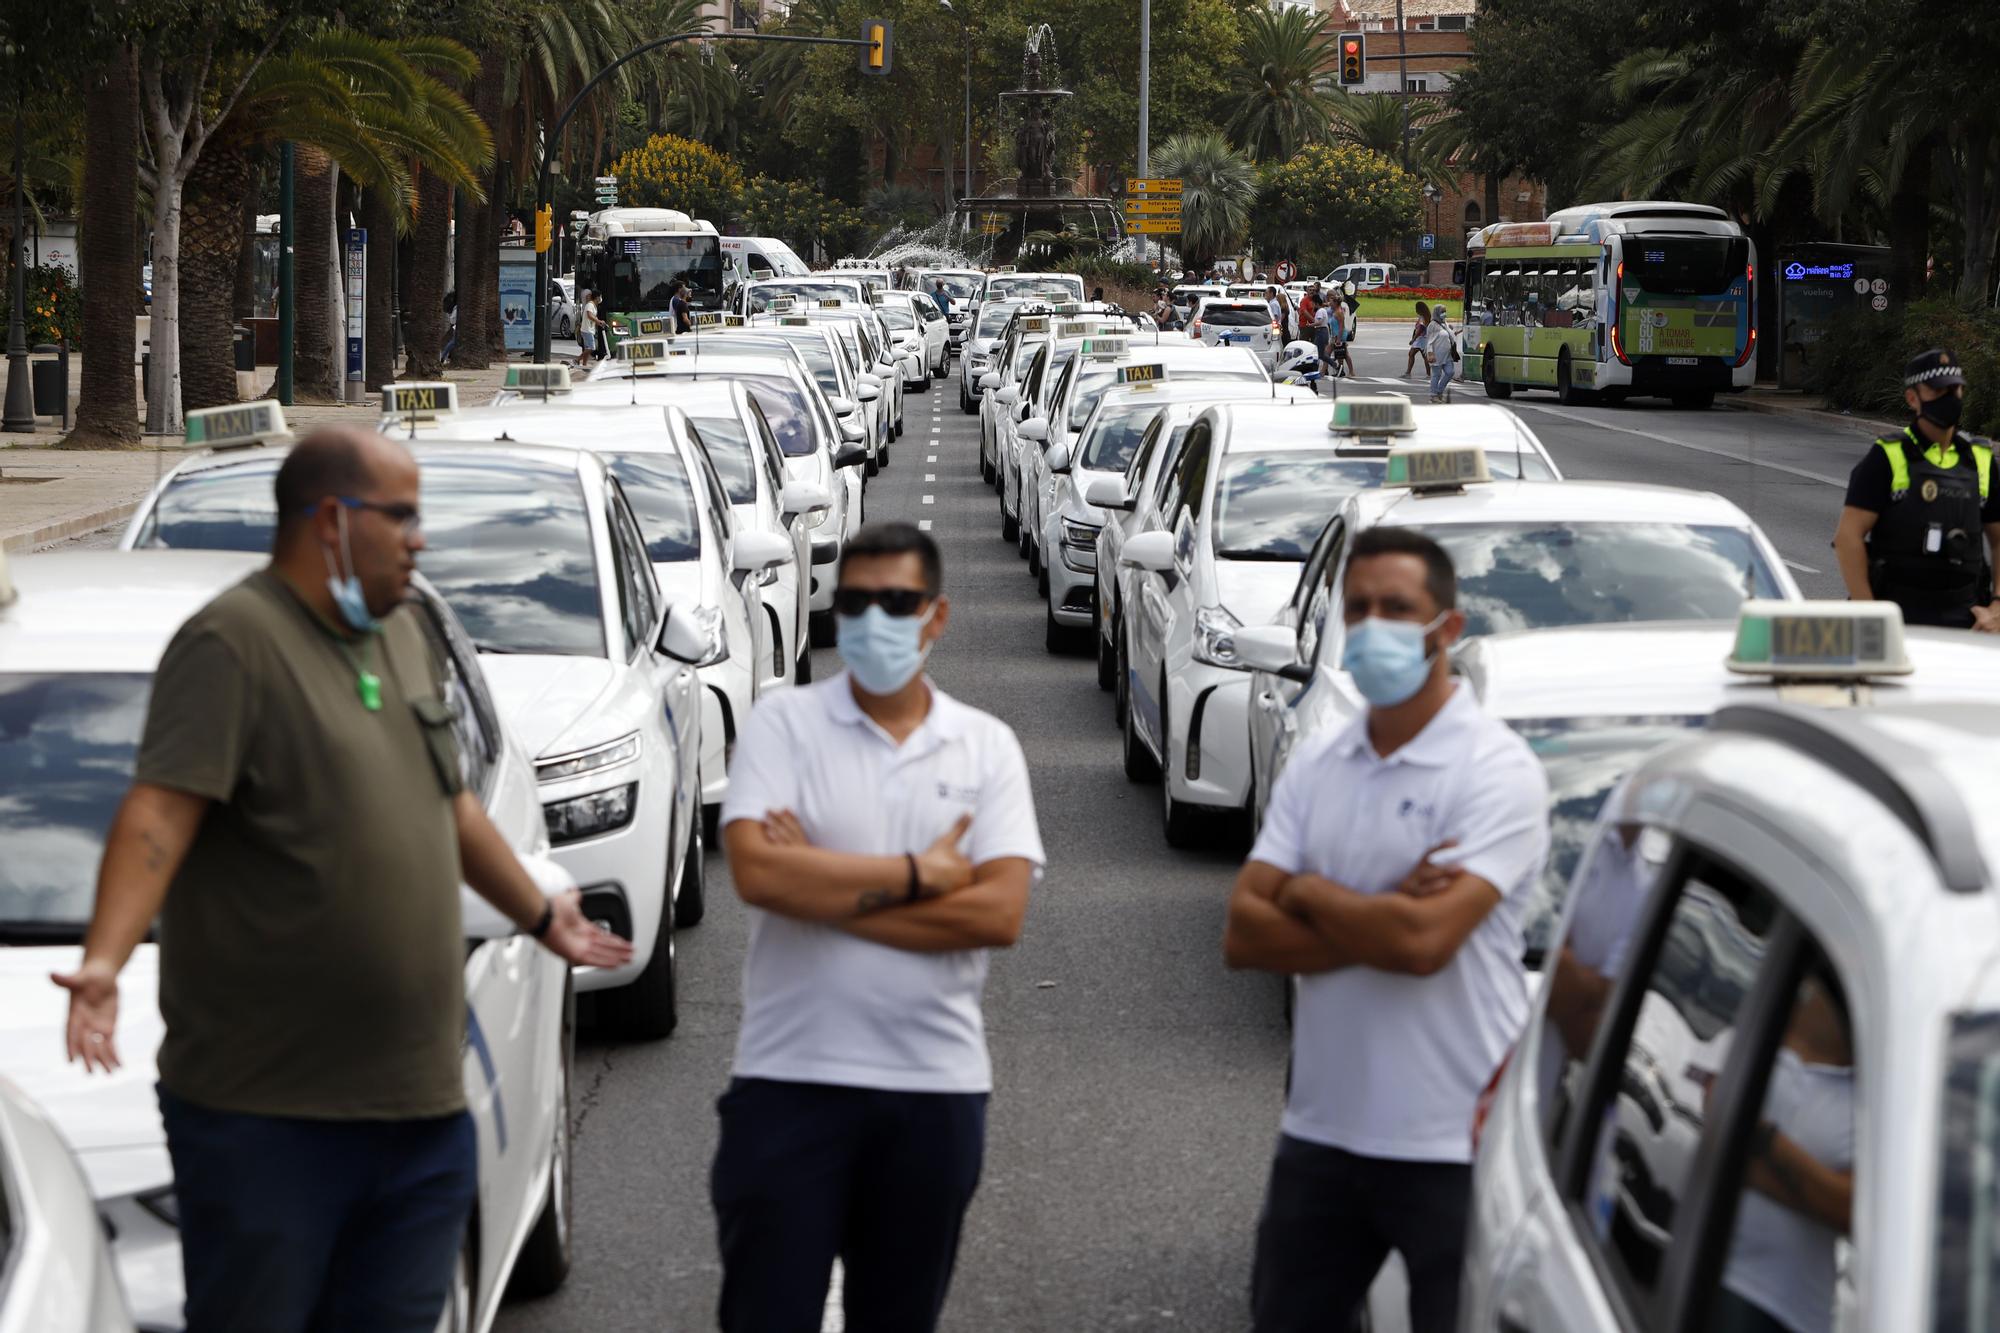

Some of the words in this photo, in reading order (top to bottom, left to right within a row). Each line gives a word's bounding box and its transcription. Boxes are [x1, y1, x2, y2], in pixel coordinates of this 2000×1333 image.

[1423, 236, 1431, 248] P
[1806, 266, 1829, 274] MAÑANA
[1873, 282, 1885, 291] 14
[1872, 298, 1886, 308] C2
[699, 315, 715, 325] TAXI
[1640, 308, 1653, 322] SE
[643, 323, 661, 332] TAXI
[726, 318, 738, 326] AXI
[1066, 323, 1085, 334] TAXI
[1666, 329, 1690, 337] TOMAR
[628, 343, 654, 358] TAXI
[1093, 340, 1114, 352] TAXI
[1640, 338, 1653, 352] RO
[1126, 366, 1153, 380] TAXI
[396, 388, 435, 409] TAXI
[1353, 404, 1389, 426] TAXI
[208, 411, 250, 436] TAXI
[1412, 453, 1457, 481] TAXI
[1779, 618, 1847, 656] TAXI
